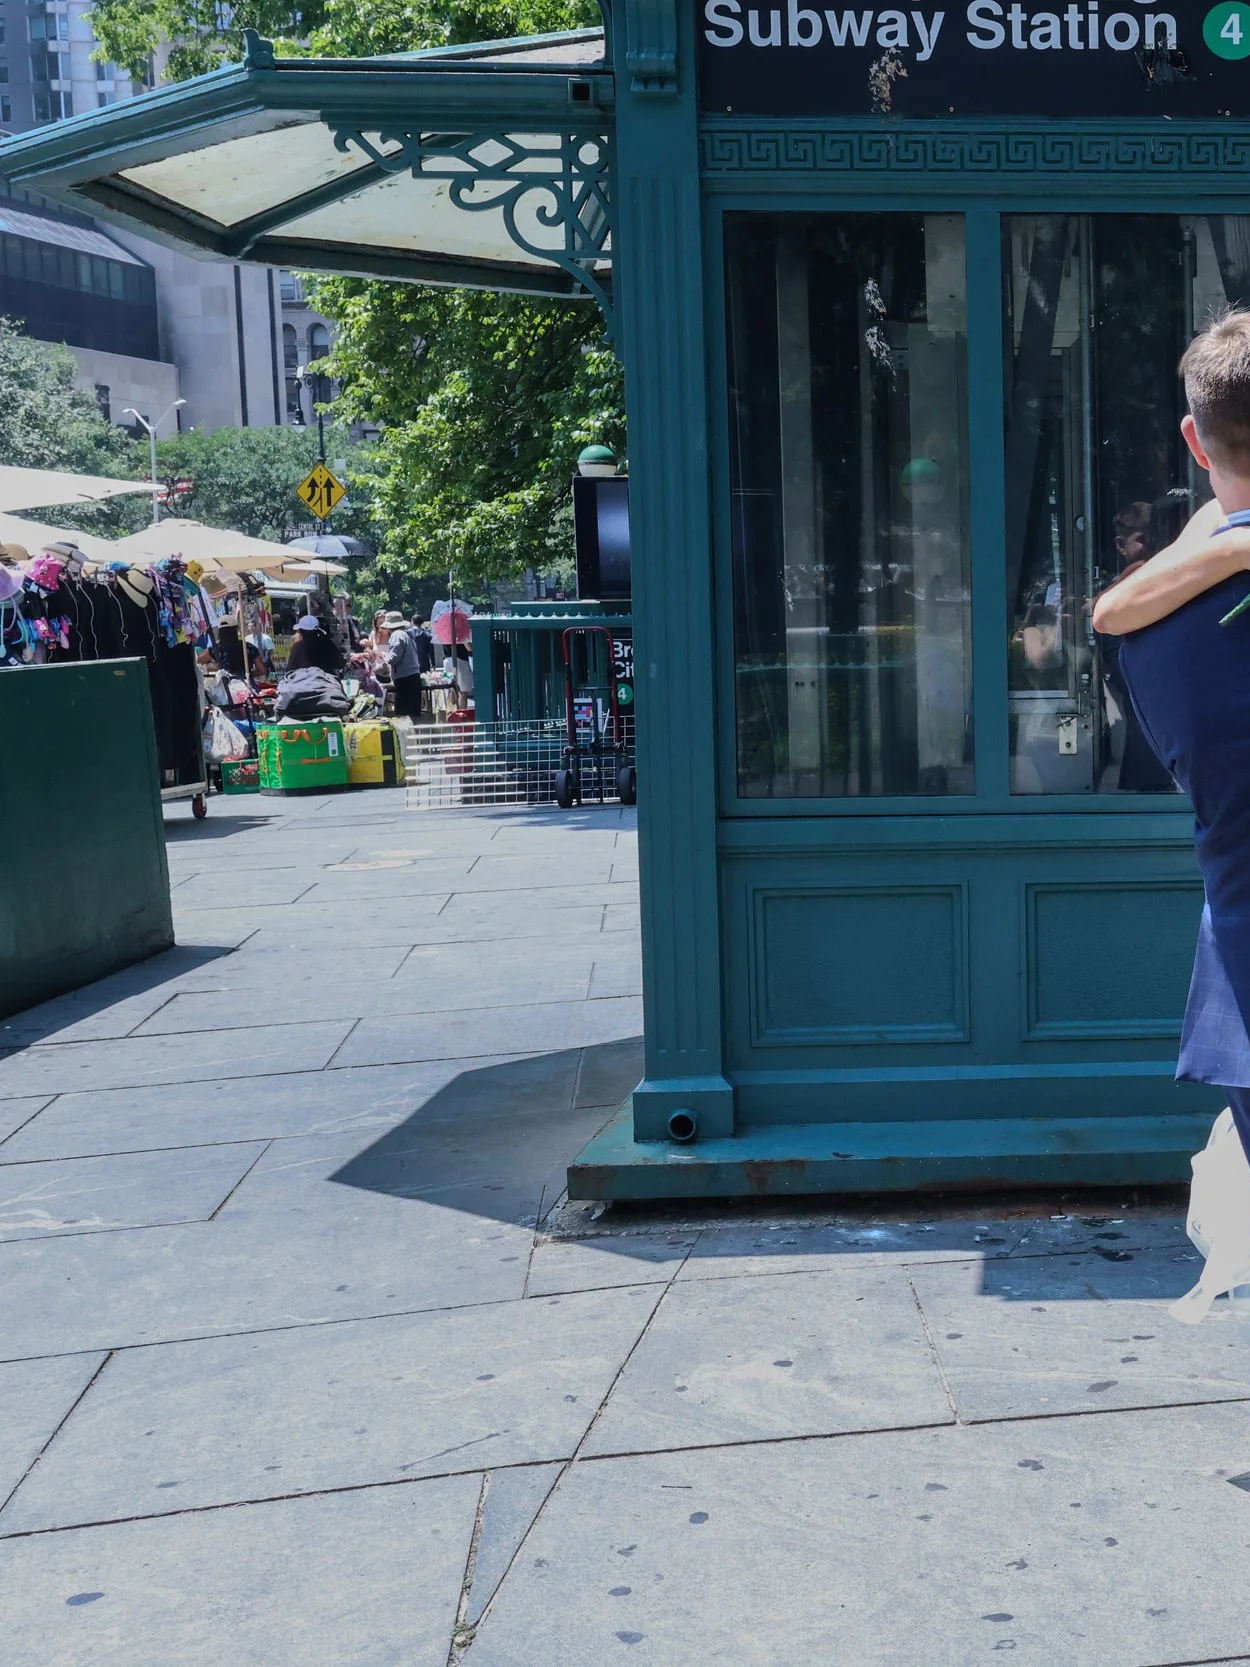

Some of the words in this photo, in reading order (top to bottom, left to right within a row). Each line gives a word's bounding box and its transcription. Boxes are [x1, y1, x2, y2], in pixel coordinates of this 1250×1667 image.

[704, 0, 945, 61] Subway
[966, 0, 1178, 50] Station
[1220, 13, 1243, 45] 4
[617, 688, 628, 700] 4
